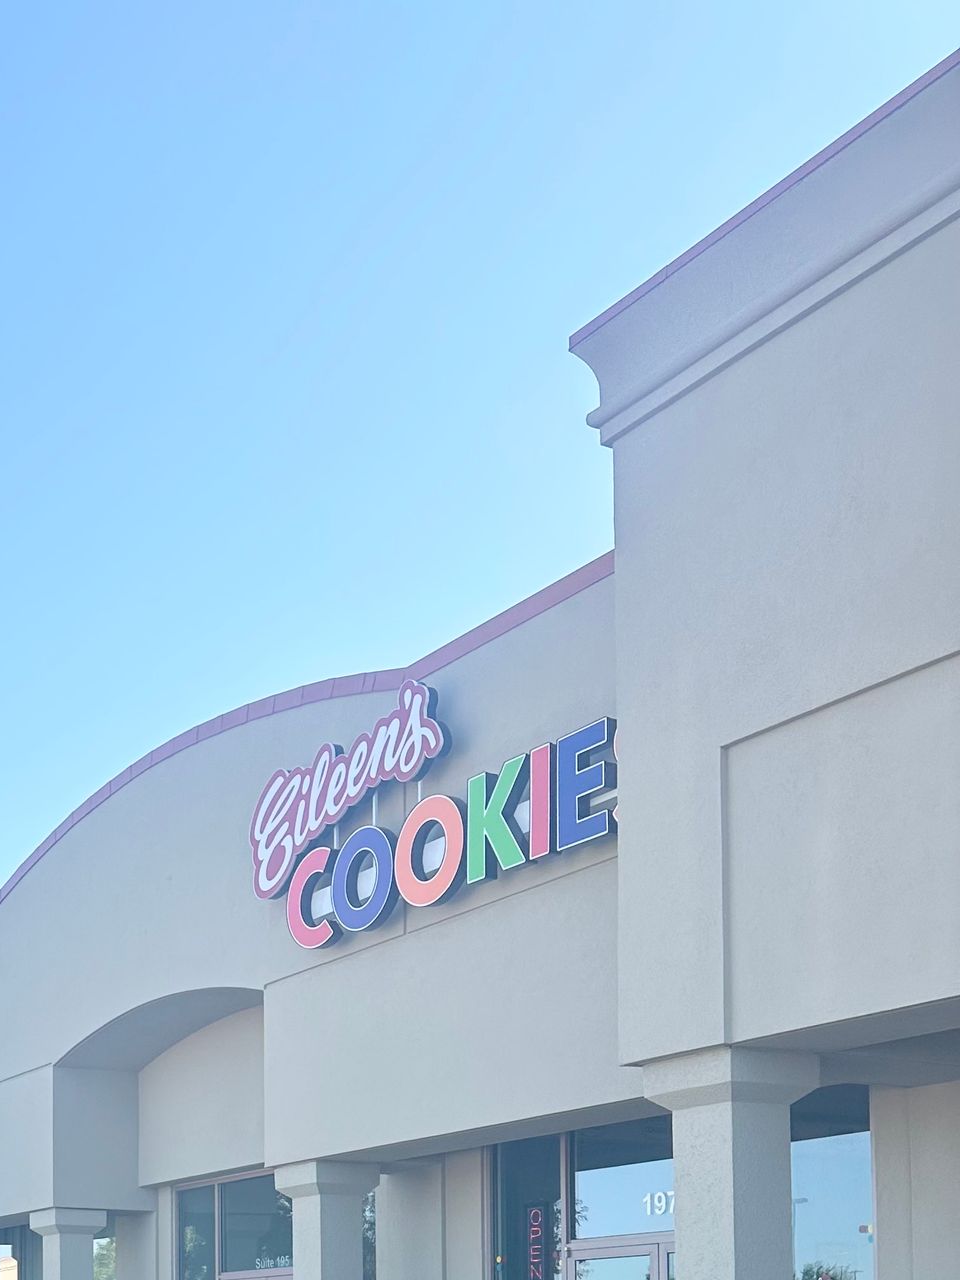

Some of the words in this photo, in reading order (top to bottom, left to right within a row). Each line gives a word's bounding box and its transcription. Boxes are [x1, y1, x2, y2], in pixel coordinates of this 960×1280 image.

[251, 682, 442, 897] Eileen's
[287, 717, 617, 949] COOKIE
[642, 1190, 675, 1216] 197
[255, 1257, 275, 1269] Suite
[276, 1255, 290, 1267] 195
[530, 1209, 542, 1280] OPEN
